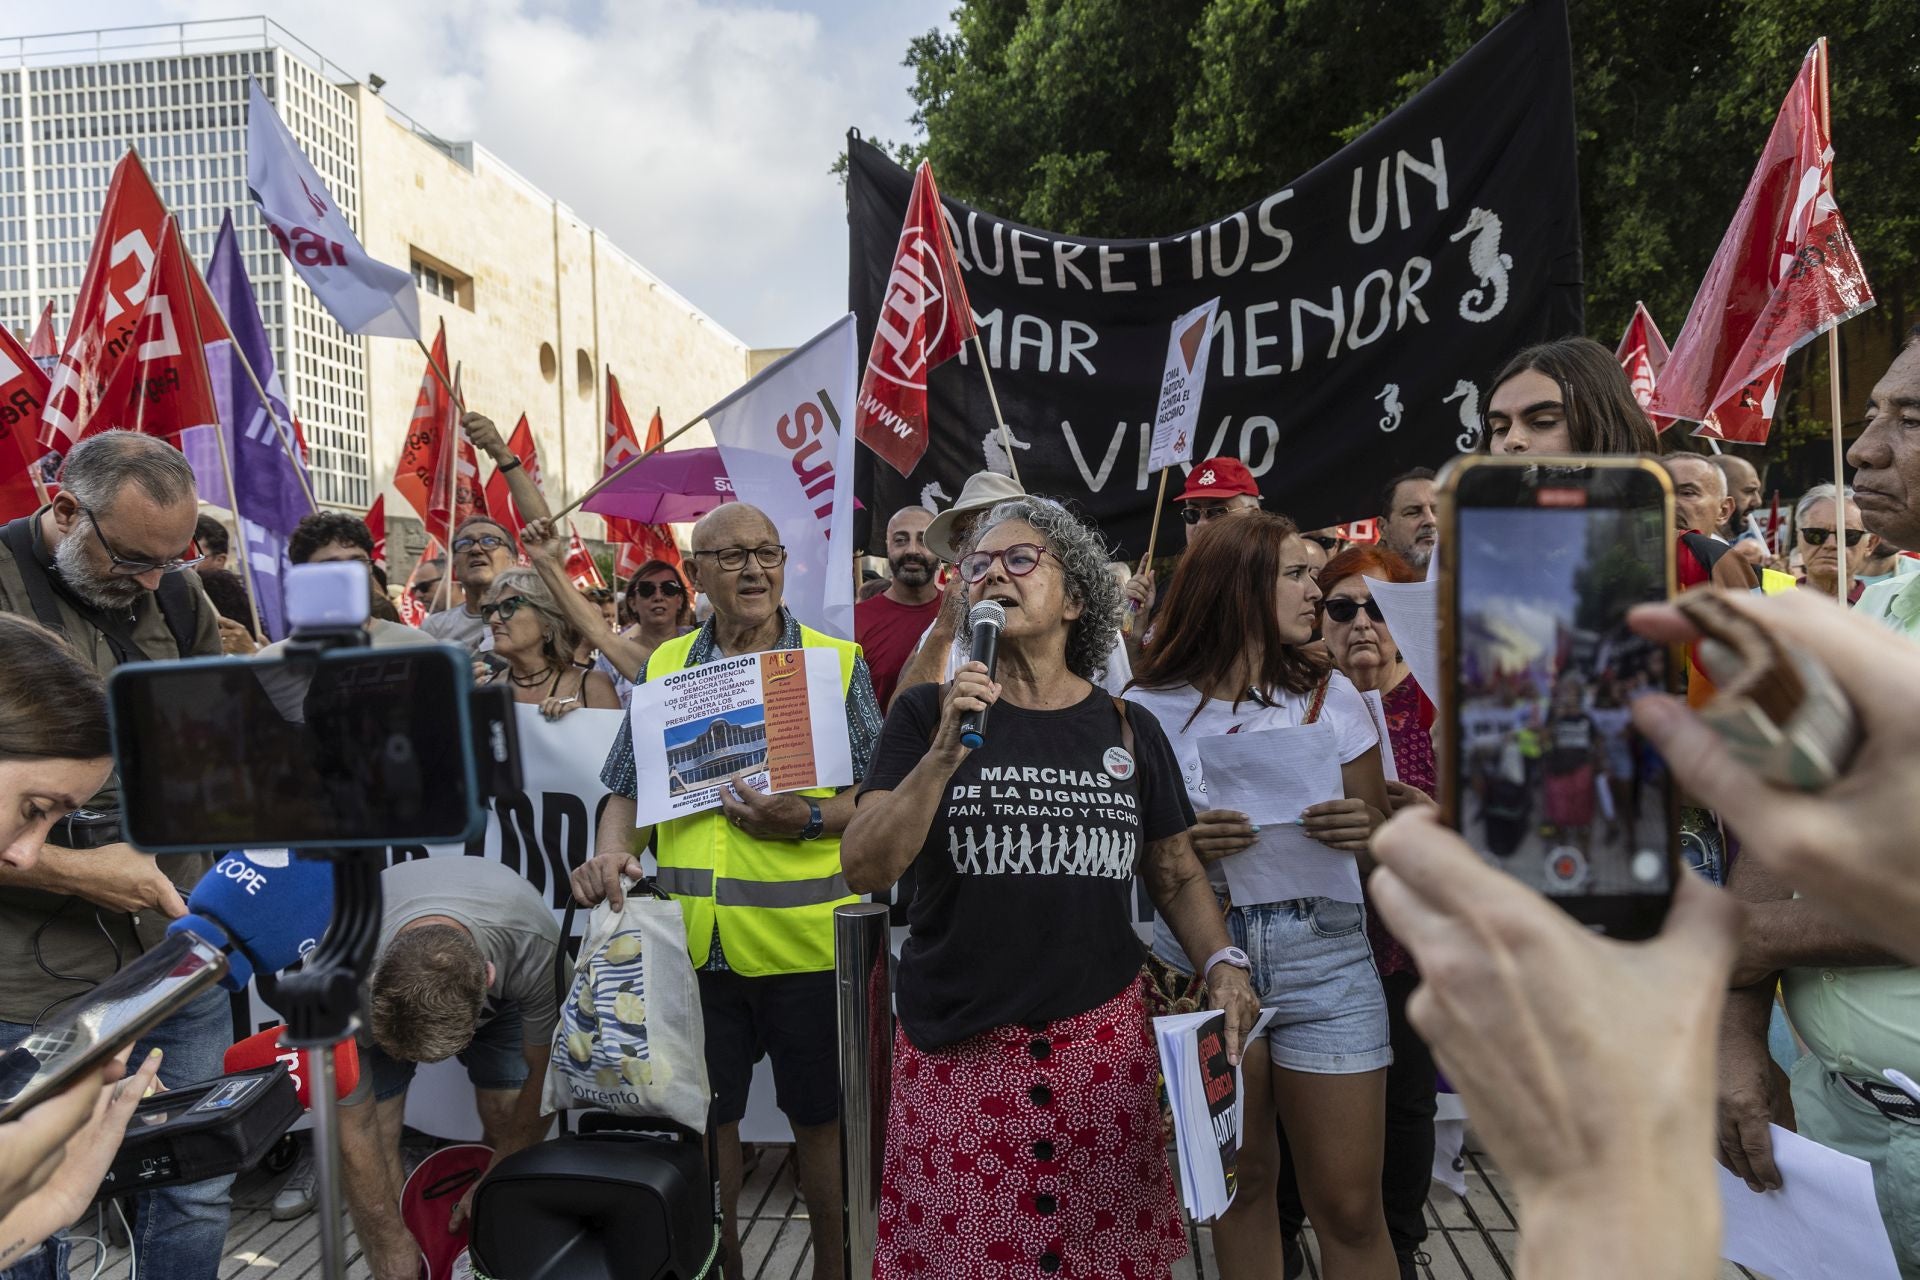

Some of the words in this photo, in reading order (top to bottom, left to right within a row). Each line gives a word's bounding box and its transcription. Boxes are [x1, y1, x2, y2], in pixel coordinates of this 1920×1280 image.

[1349, 137, 1449, 244] UN
[959, 307, 1098, 375] MAR
[1165, 367, 1180, 382] TOMA
[1162, 378, 1185, 398] PARTIDO
[1160, 391, 1181, 412] CONTRA
[1182, 389, 1190, 403] EL
[1157, 404, 1186, 425] FASCISMO
[664, 657, 756, 687] CONCENTRACIÓN
[769, 652, 794, 669] MHC
[672, 680, 687, 692] POR
[687, 679, 697, 688] LA
[698, 668, 746, 686] CONVIVENCIA
[683, 677, 734, 695] DEMOCRÁTICA
[664, 697, 678, 707] LOS
[678, 688, 718, 703] DERECHOS
[719, 679, 755, 694] HUMANOS
[677, 700, 688, 709] DE
[689, 698, 698, 707] LA
[665, 708, 720, 727] PRESUPUESTOS
[721, 702, 736, 713] DEL
[687, 701, 717, 713] CONTRA
[718, 697, 733, 706] LOS
[980, 766, 1112, 788] MARCHAS
[952, 785, 982, 800] DE
[990, 785, 1021, 799] LA
[1029, 788, 1136, 809] DIGNIDAD
[947, 804, 986, 818] PAN,
[993, 804, 1074, 817] TRABAJO
[1079, 807, 1090, 818] Y
[1095, 808, 1139, 826] TECHO
[215, 858, 267, 896] COPE
[1206, 1071, 1234, 1105] MURCIA
